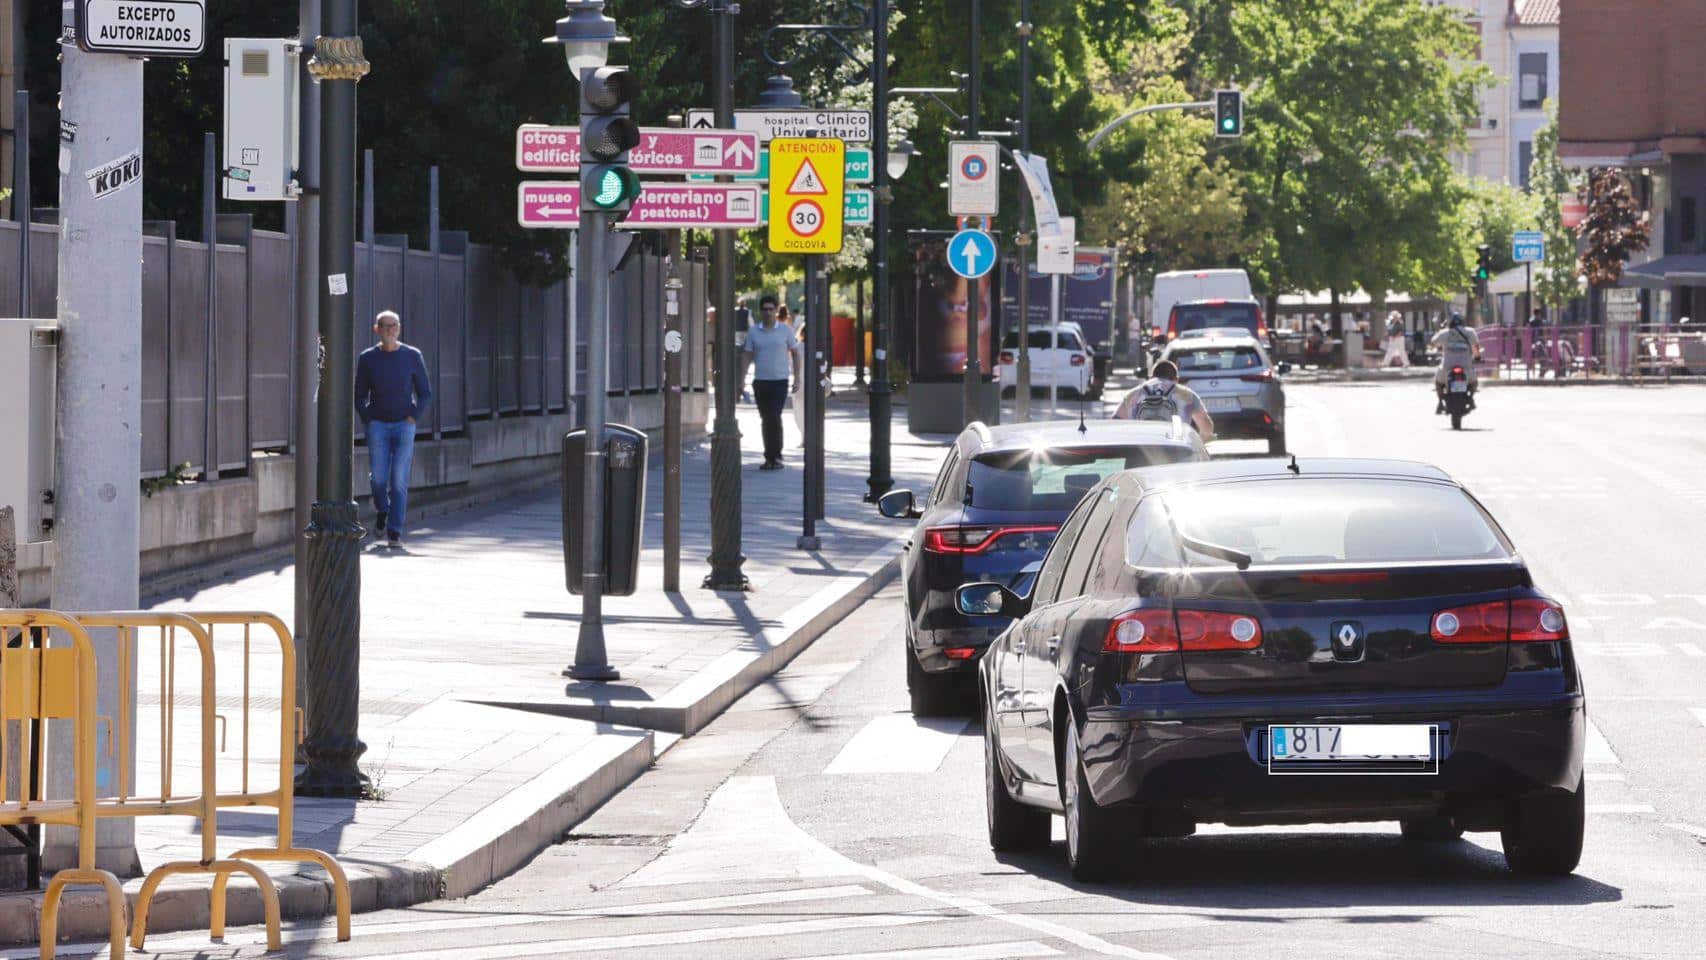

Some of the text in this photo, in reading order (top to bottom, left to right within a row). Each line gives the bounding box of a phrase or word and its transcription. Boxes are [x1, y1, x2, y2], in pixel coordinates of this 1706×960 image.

[118, 6, 176, 22] EXCEPTO
[100, 25, 191, 42] AUTORIZADOS
[764, 116, 809, 127] hospital
[771, 126, 867, 138] Univsitario
[524, 131, 567, 145] otros
[648, 135, 658, 149] y
[778, 142, 837, 153] ATENCIÓN
[523, 148, 684, 164] edificio tóricos
[845, 161, 868, 174] yor
[95, 157, 140, 194] KOKO
[525, 193, 573, 203] museo
[639, 205, 710, 220] peatonal)
[795, 212, 817, 225] 30
[1292, 727, 1341, 753] 817
